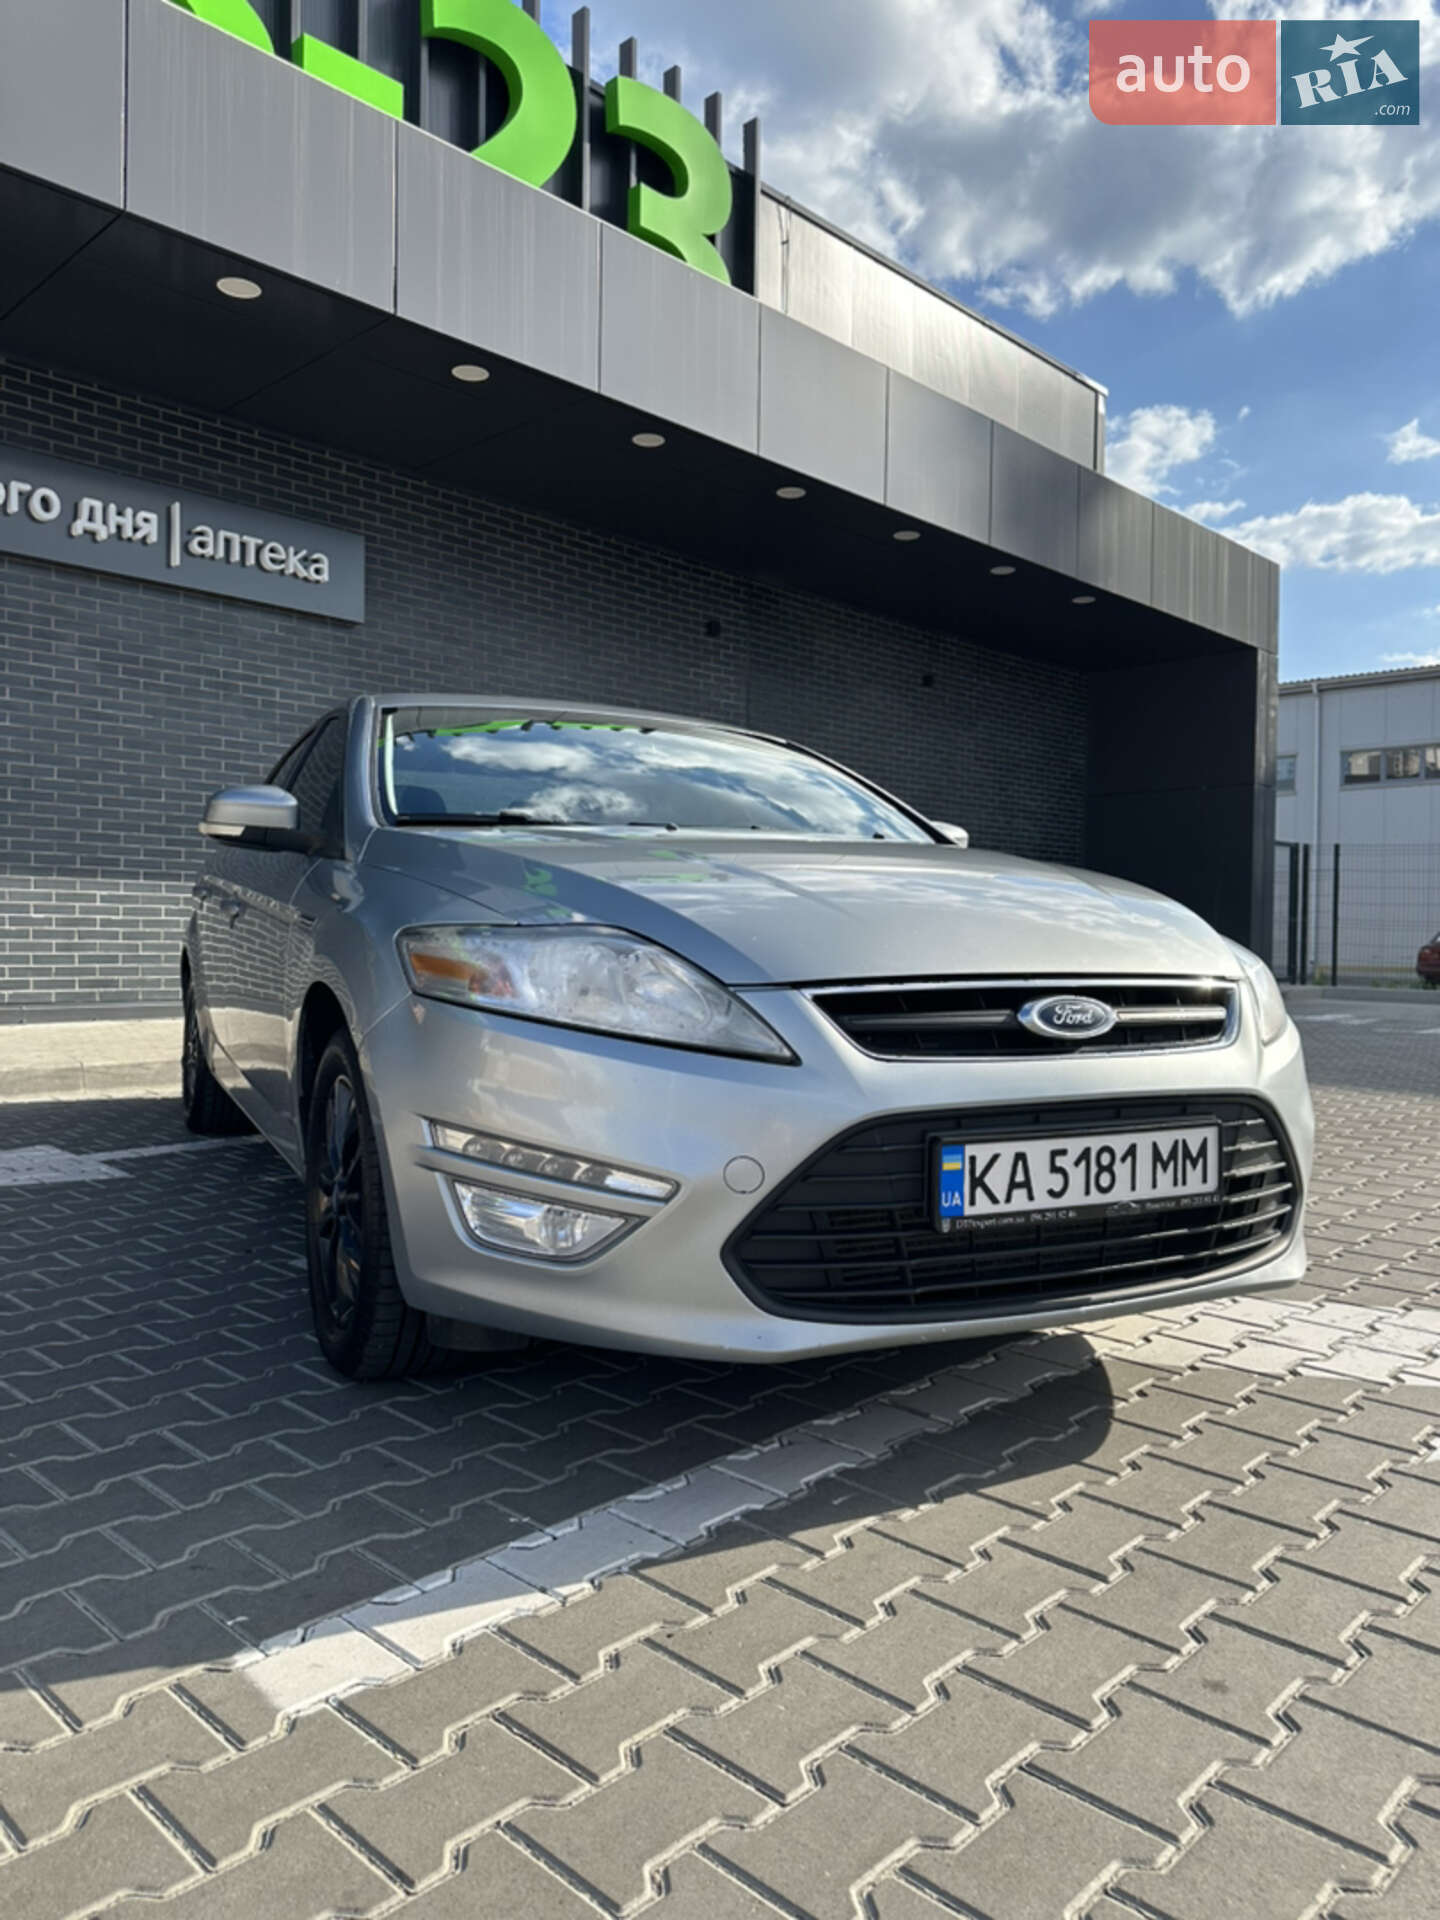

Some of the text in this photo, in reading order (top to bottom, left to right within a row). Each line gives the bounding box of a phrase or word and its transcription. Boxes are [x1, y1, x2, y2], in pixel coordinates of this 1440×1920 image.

[0, 480, 330, 583] го дня аптека
[1053, 1004, 1093, 1025] Ford
[941, 1136, 1208, 1207] UA KA 5181 MM
